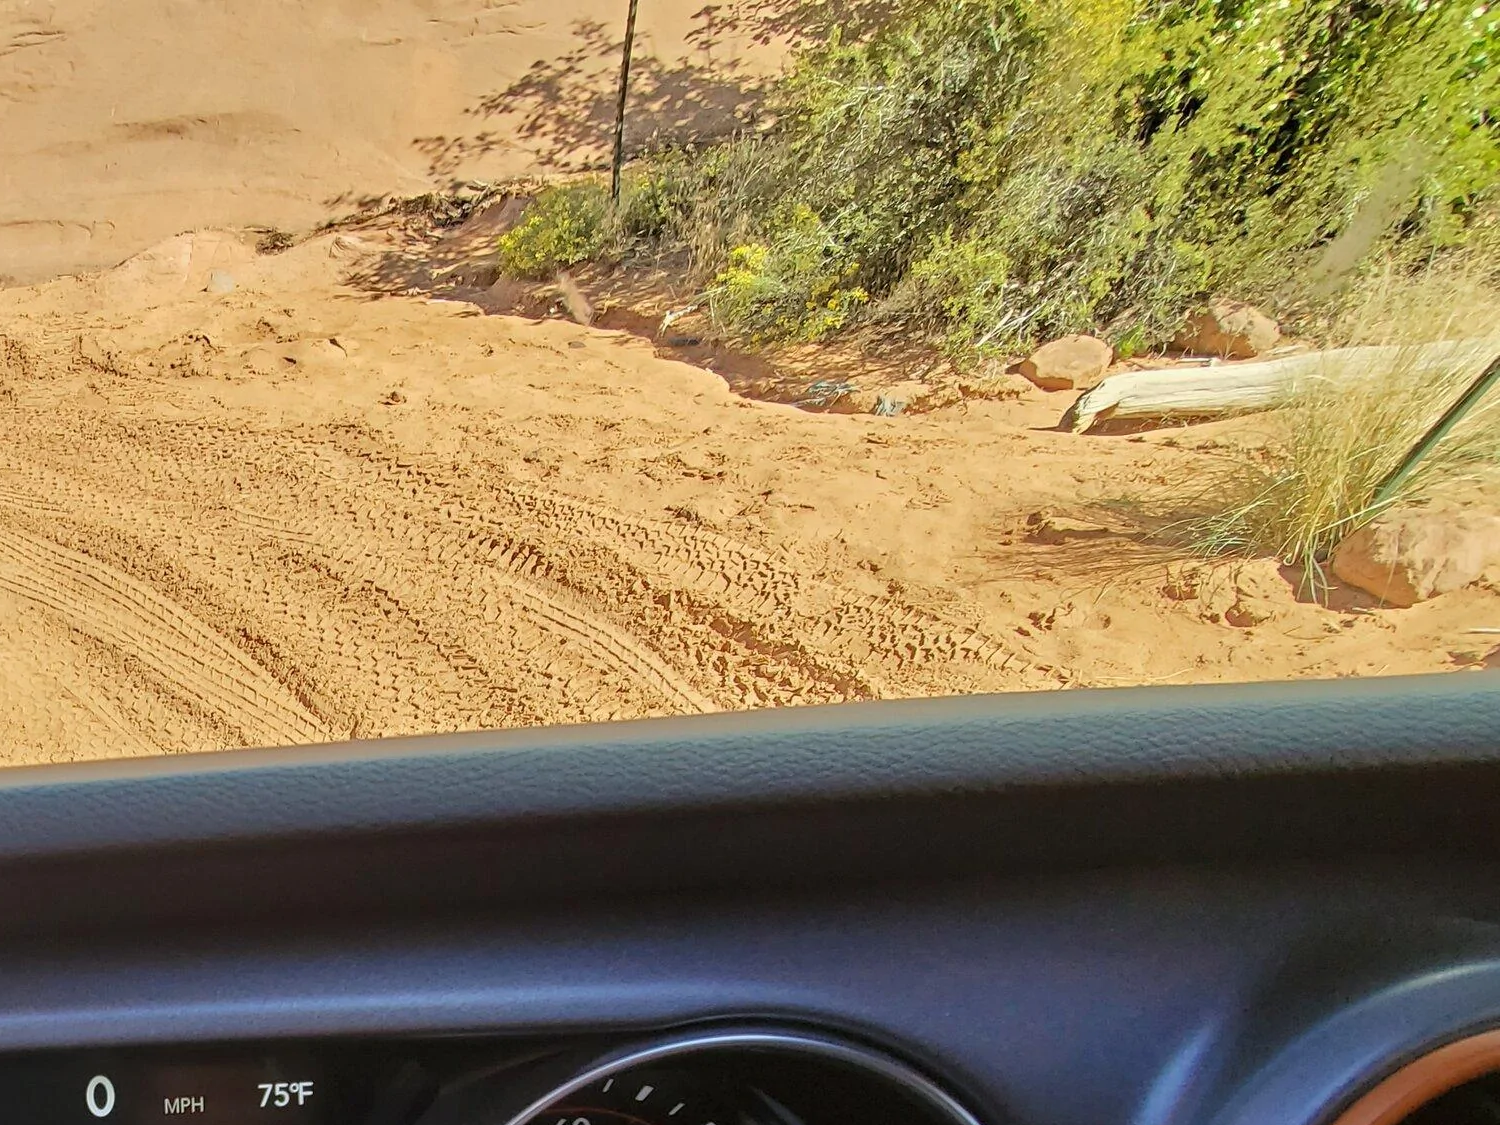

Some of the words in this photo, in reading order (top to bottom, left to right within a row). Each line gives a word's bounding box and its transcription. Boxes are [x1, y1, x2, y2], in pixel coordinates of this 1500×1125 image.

[86, 1075, 115, 1117] 0
[164, 1096, 205, 1115] MPH
[257, 1081, 314, 1108] 75°F
